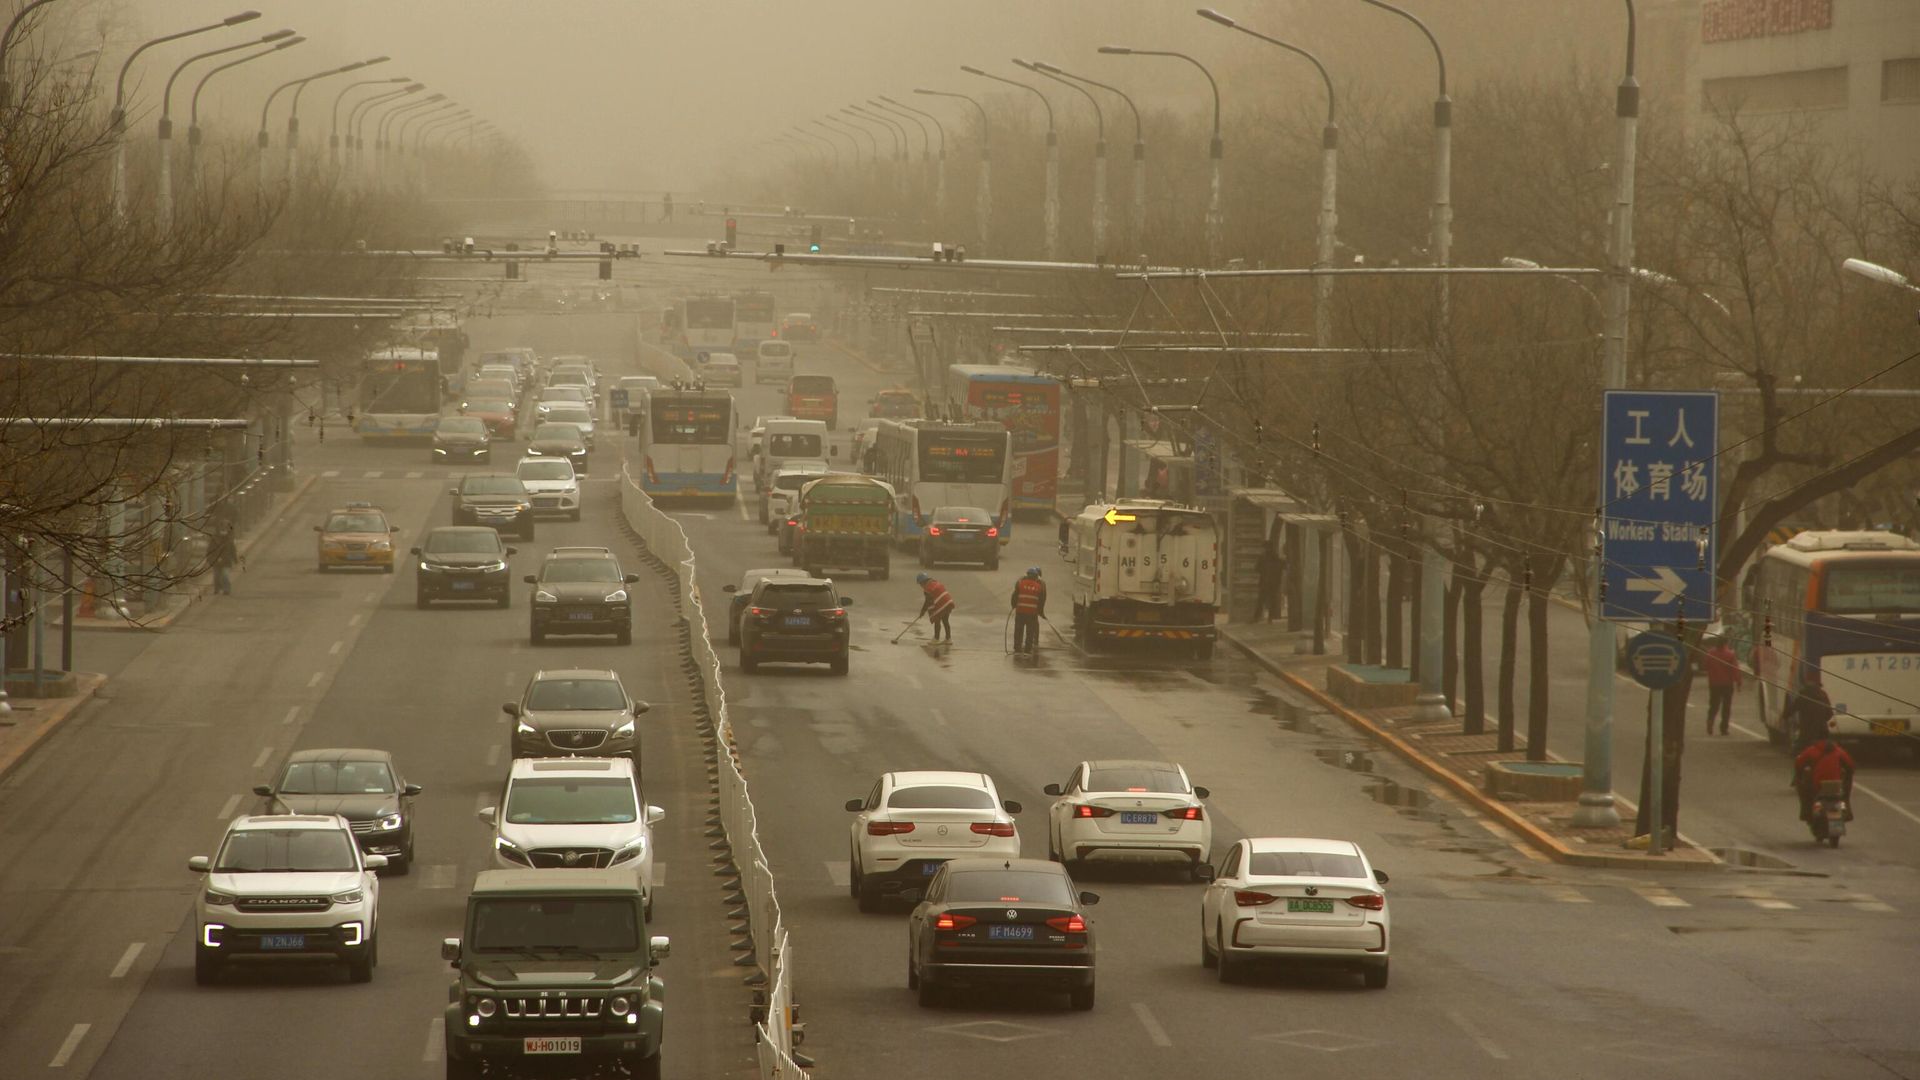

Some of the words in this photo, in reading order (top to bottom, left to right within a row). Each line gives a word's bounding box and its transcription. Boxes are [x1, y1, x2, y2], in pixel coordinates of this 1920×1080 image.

[1625, 408, 1694, 448] 工人
[1614, 459, 1708, 501] 体育场
